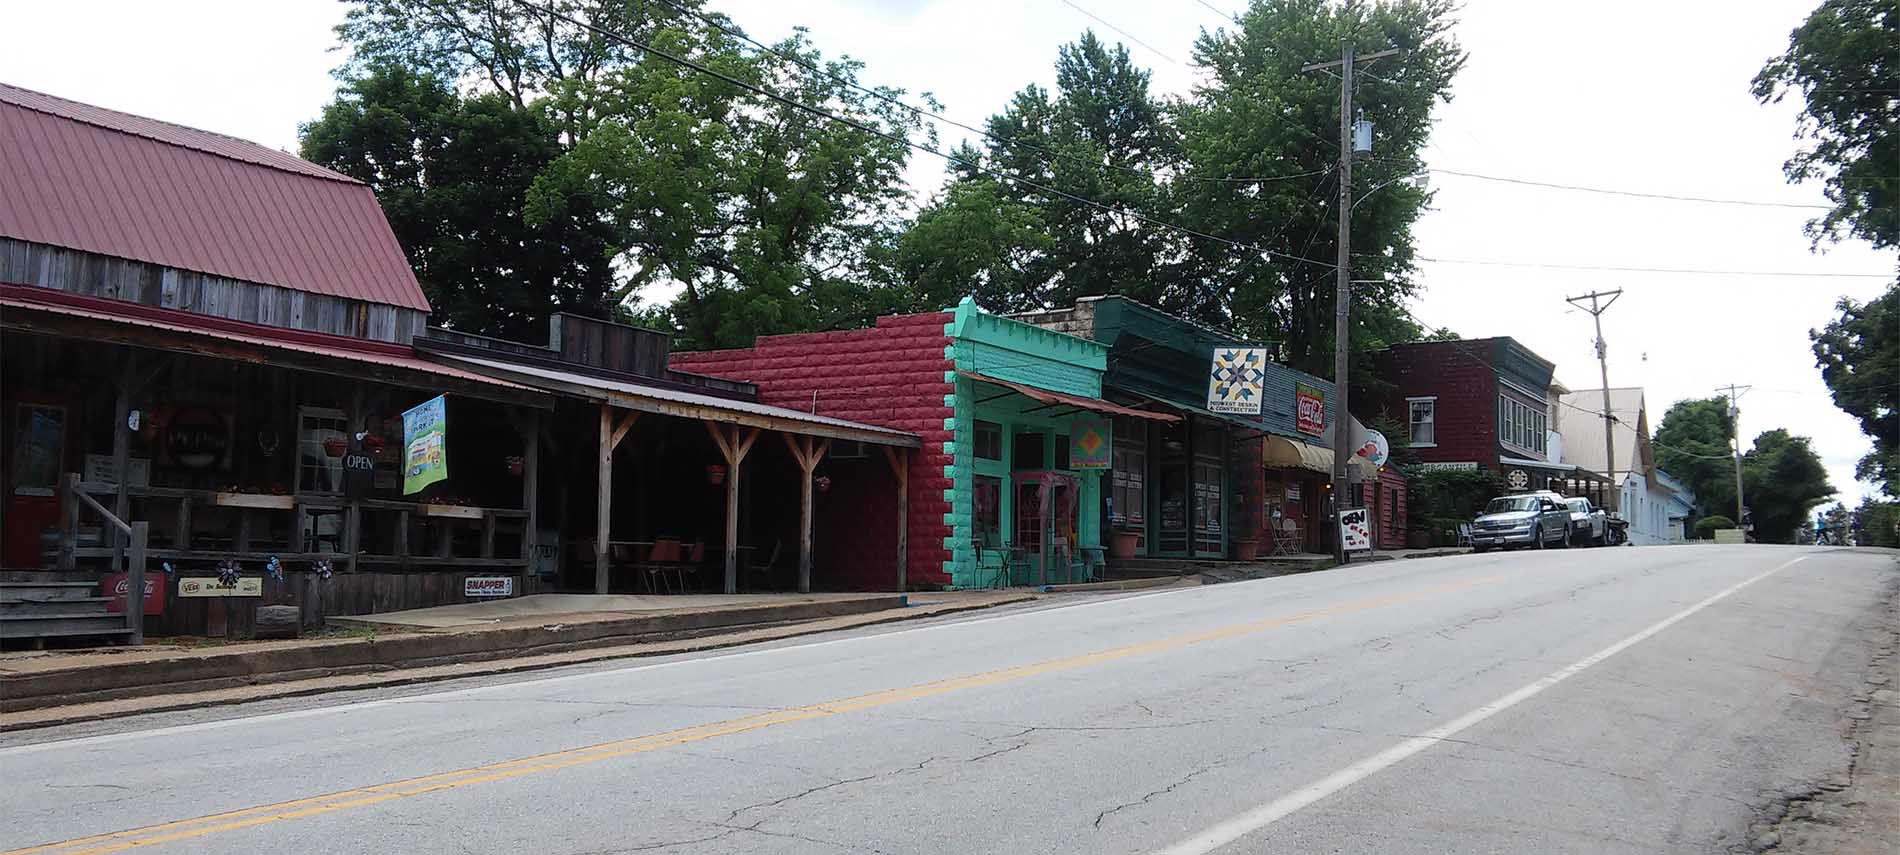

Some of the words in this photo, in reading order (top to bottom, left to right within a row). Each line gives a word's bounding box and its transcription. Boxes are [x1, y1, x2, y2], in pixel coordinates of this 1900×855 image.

[346, 455, 374, 470] OPEN
[1342, 510, 1365, 525] OPEN
[466, 580, 505, 590] SNAPPER
